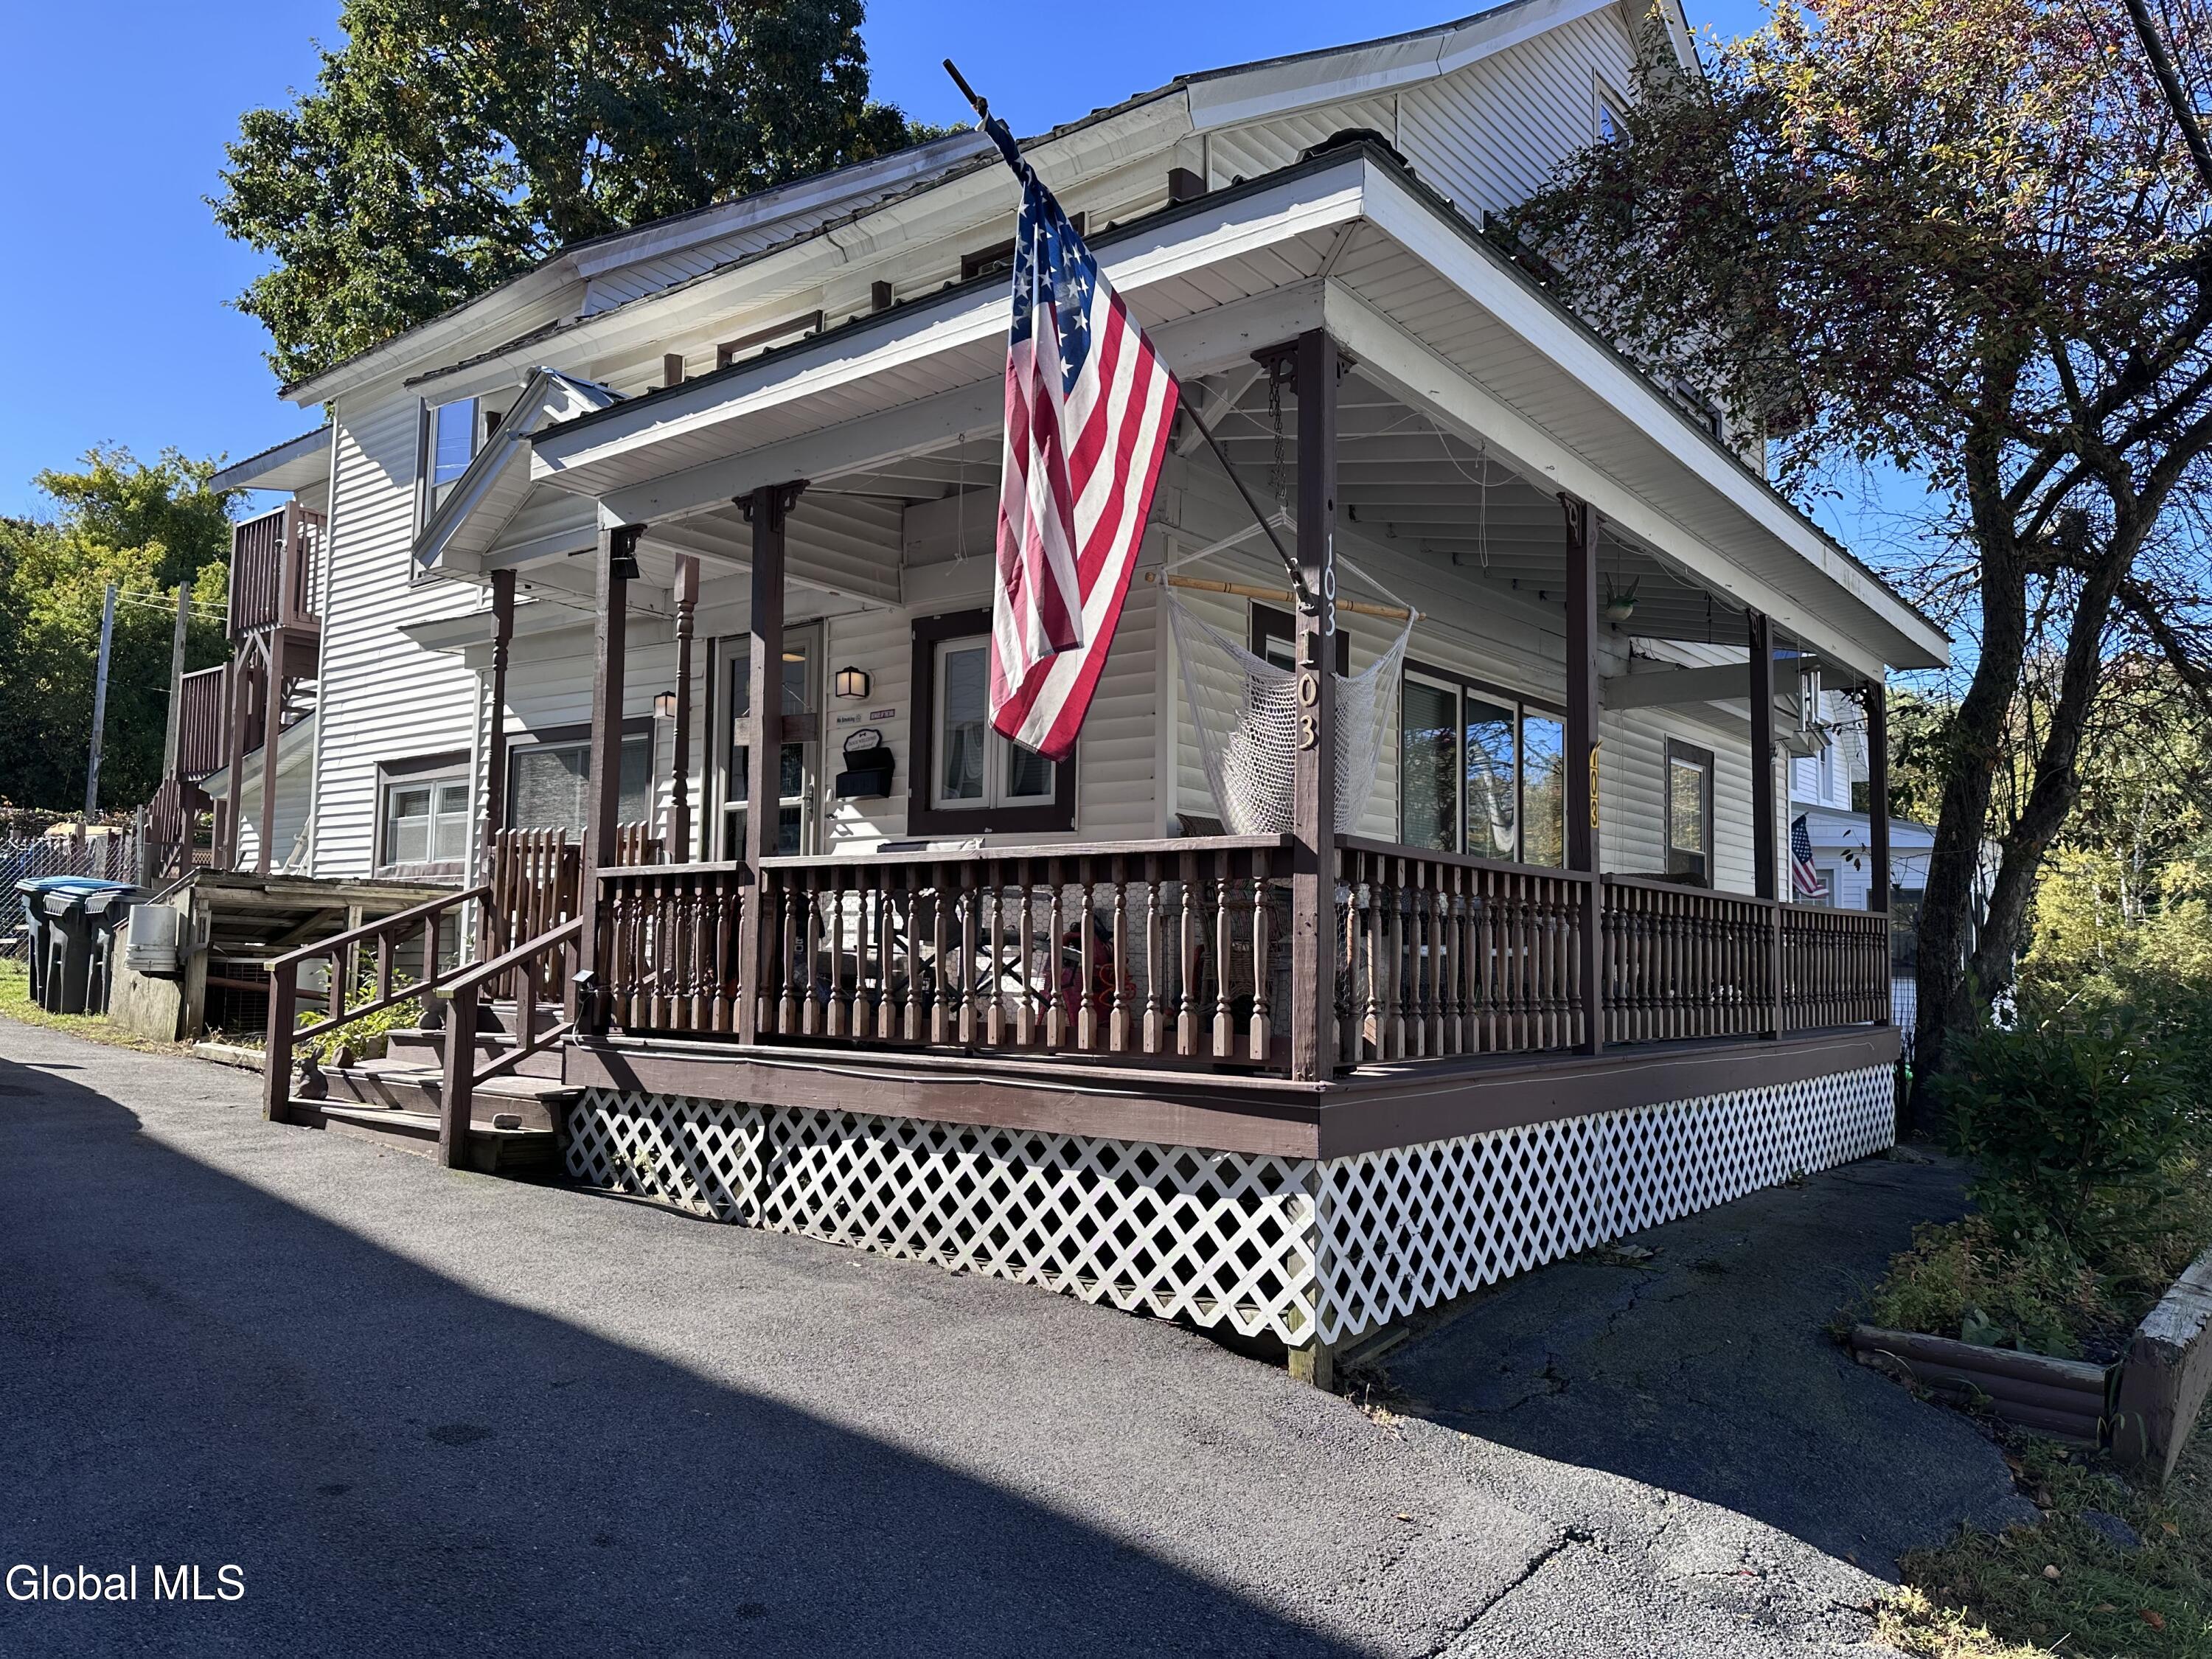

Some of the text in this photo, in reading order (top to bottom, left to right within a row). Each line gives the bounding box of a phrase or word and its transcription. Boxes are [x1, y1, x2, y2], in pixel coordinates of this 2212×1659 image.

[1325, 533, 1336, 637] 103
[1298, 628, 1317, 750] 103
[1590, 740, 1601, 827] 103
